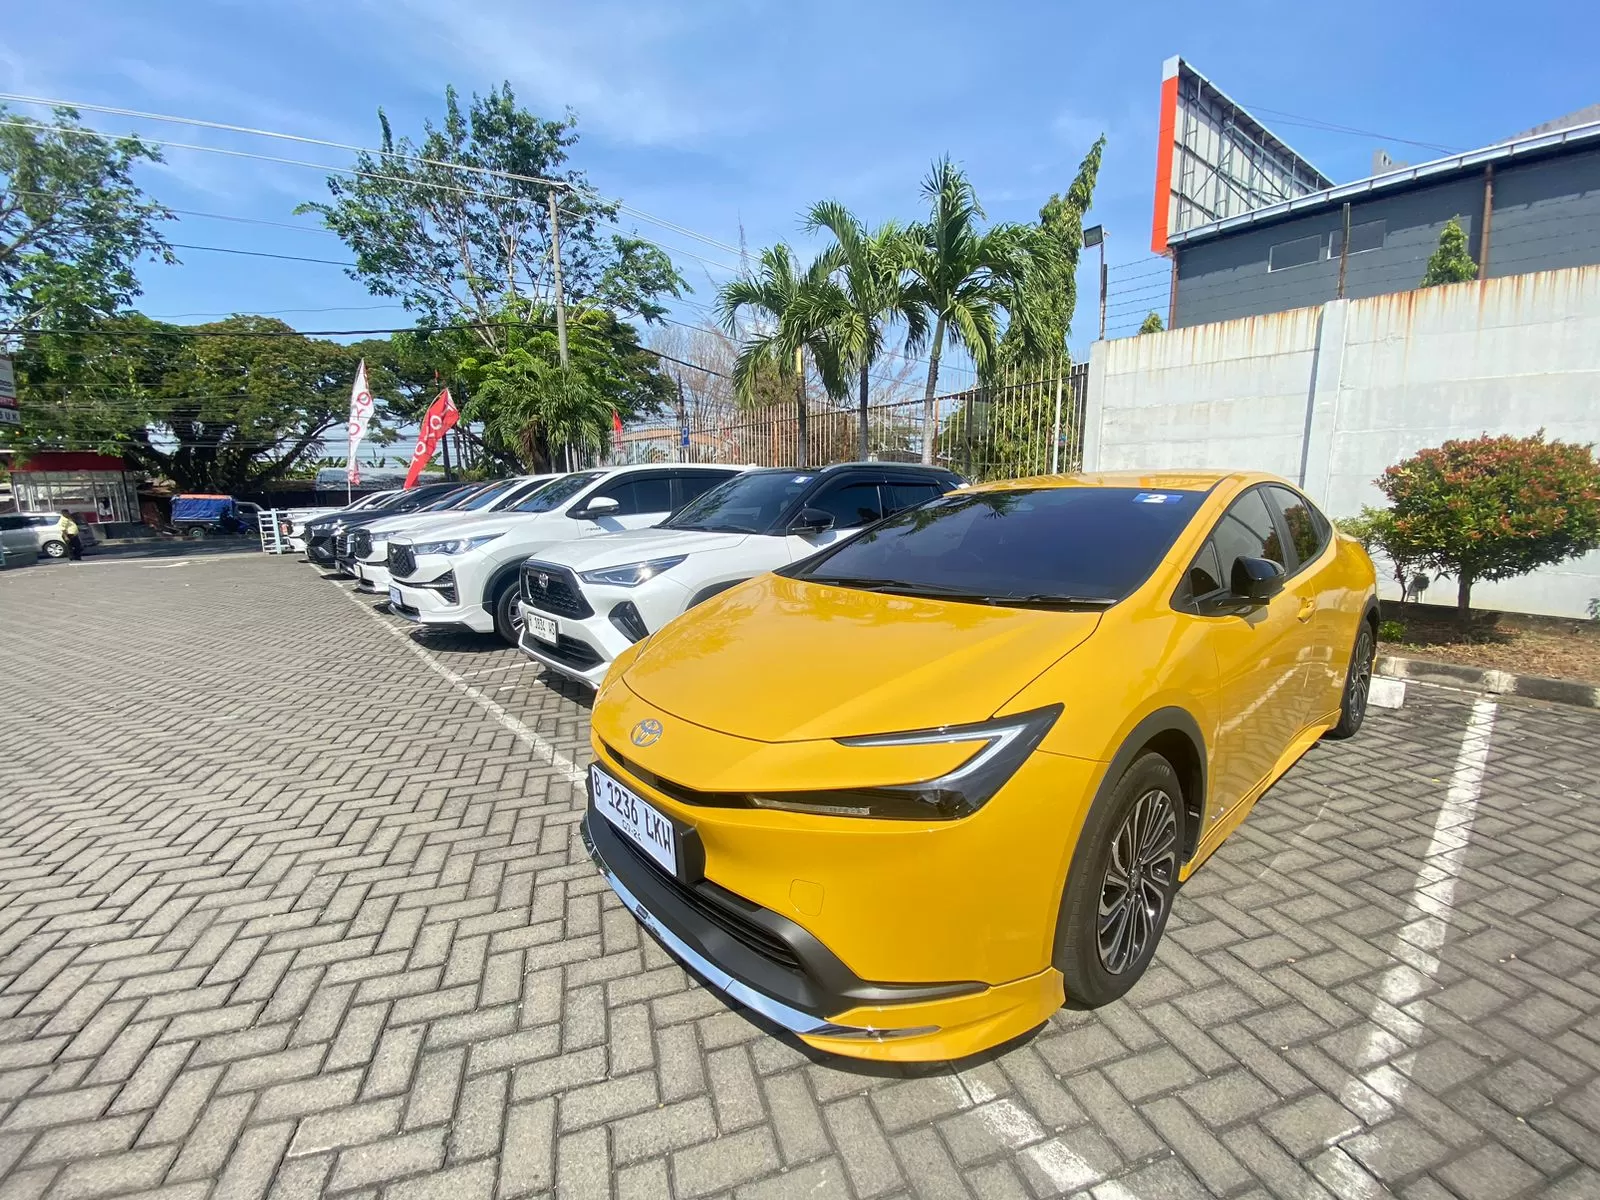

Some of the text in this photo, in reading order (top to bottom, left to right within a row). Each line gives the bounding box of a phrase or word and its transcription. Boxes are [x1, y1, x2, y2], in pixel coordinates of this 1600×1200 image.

[1143, 494, 1168, 504] 2
[594, 771, 602, 797] B
[606, 781, 639, 826] 1236
